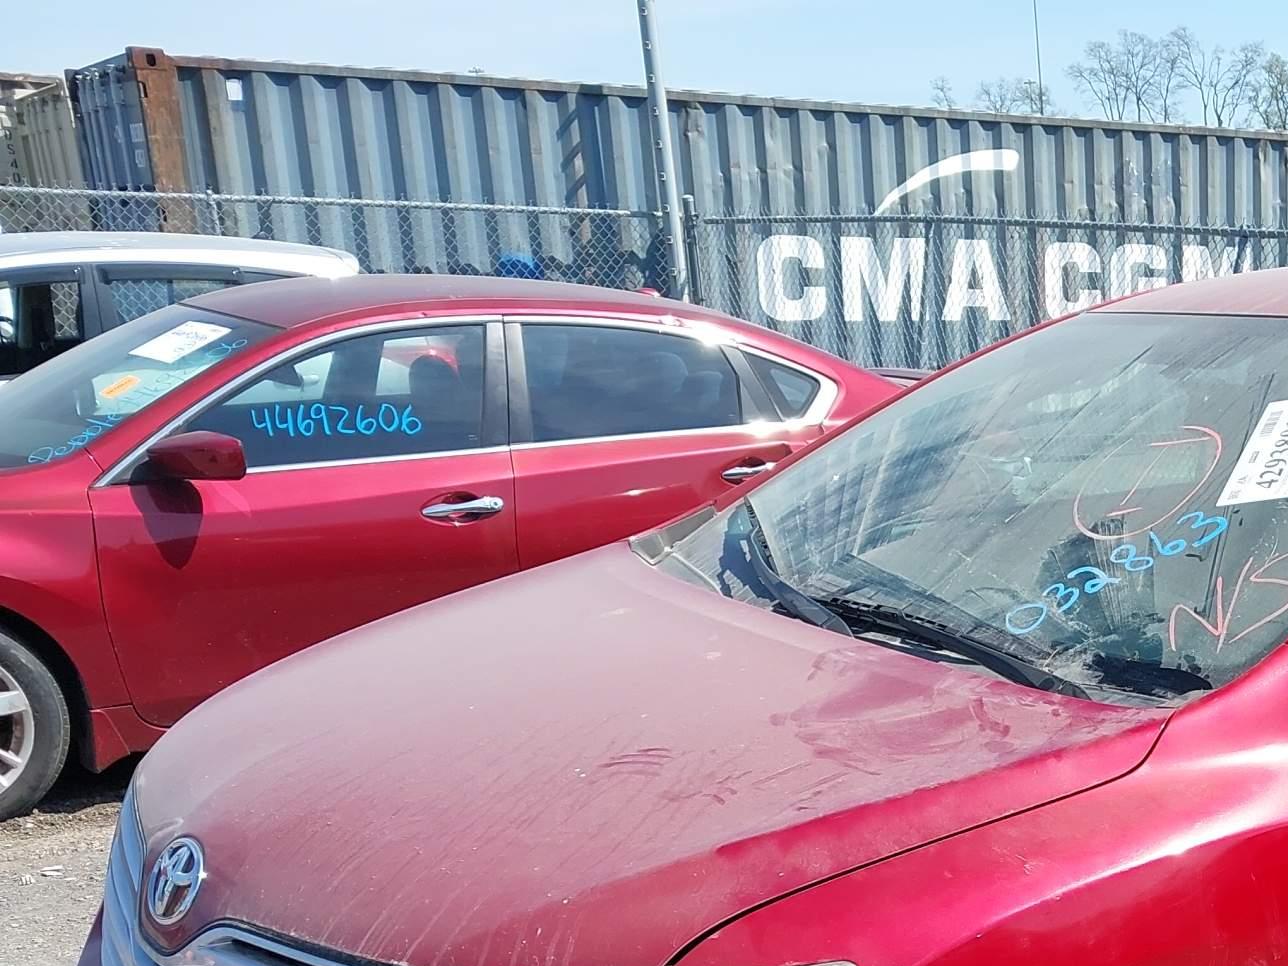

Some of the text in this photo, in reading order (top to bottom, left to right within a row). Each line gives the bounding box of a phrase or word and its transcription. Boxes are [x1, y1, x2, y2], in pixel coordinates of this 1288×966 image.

[756, 234, 1011, 321] CMA
[250, 402, 423, 438] 44692606
[1005, 511, 1229, 635] 032863
